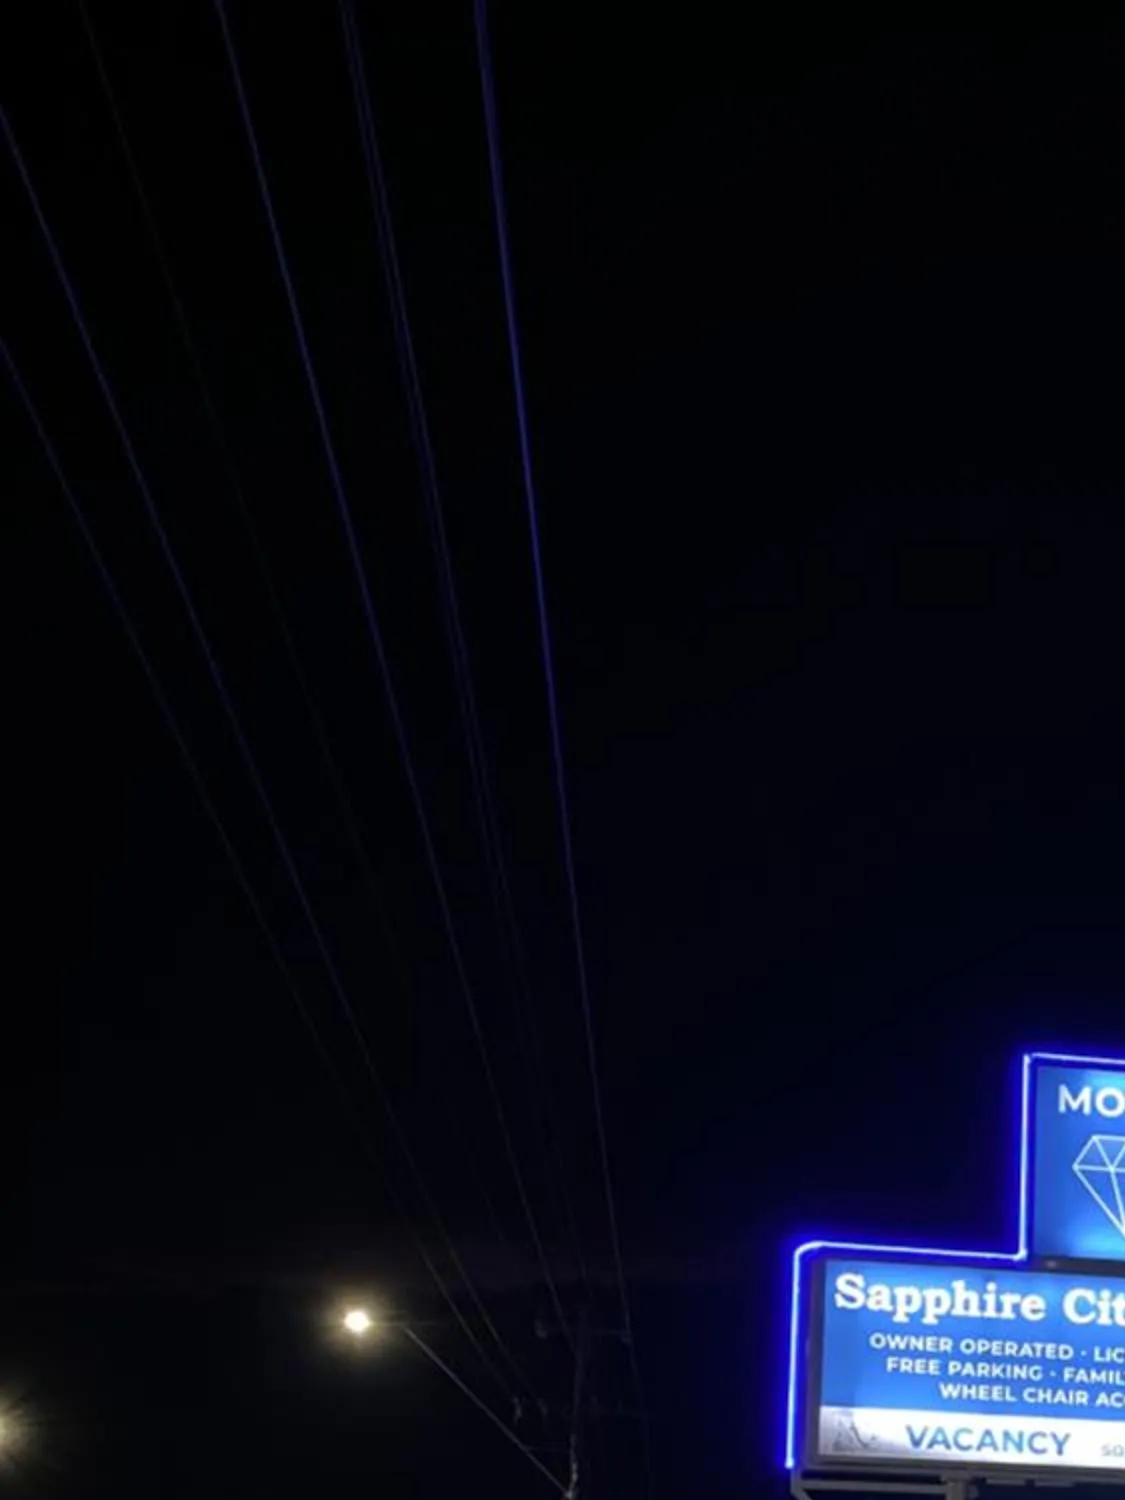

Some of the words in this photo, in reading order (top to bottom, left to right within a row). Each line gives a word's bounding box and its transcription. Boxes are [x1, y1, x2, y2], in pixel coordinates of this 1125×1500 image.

[834, 1272, 1047, 1325] Sapphire
[869, 1333, 953, 1352] OWNER
[960, 1338, 1074, 1360] OPERATED
[886, 1357, 940, 1375] FREE
[948, 1360, 1043, 1380] PARKING
[938, 1382, 1017, 1402] WHEEL
[1023, 1388, 1089, 1406] CHAIR
[906, 1424, 1071, 1457] VACANCY
